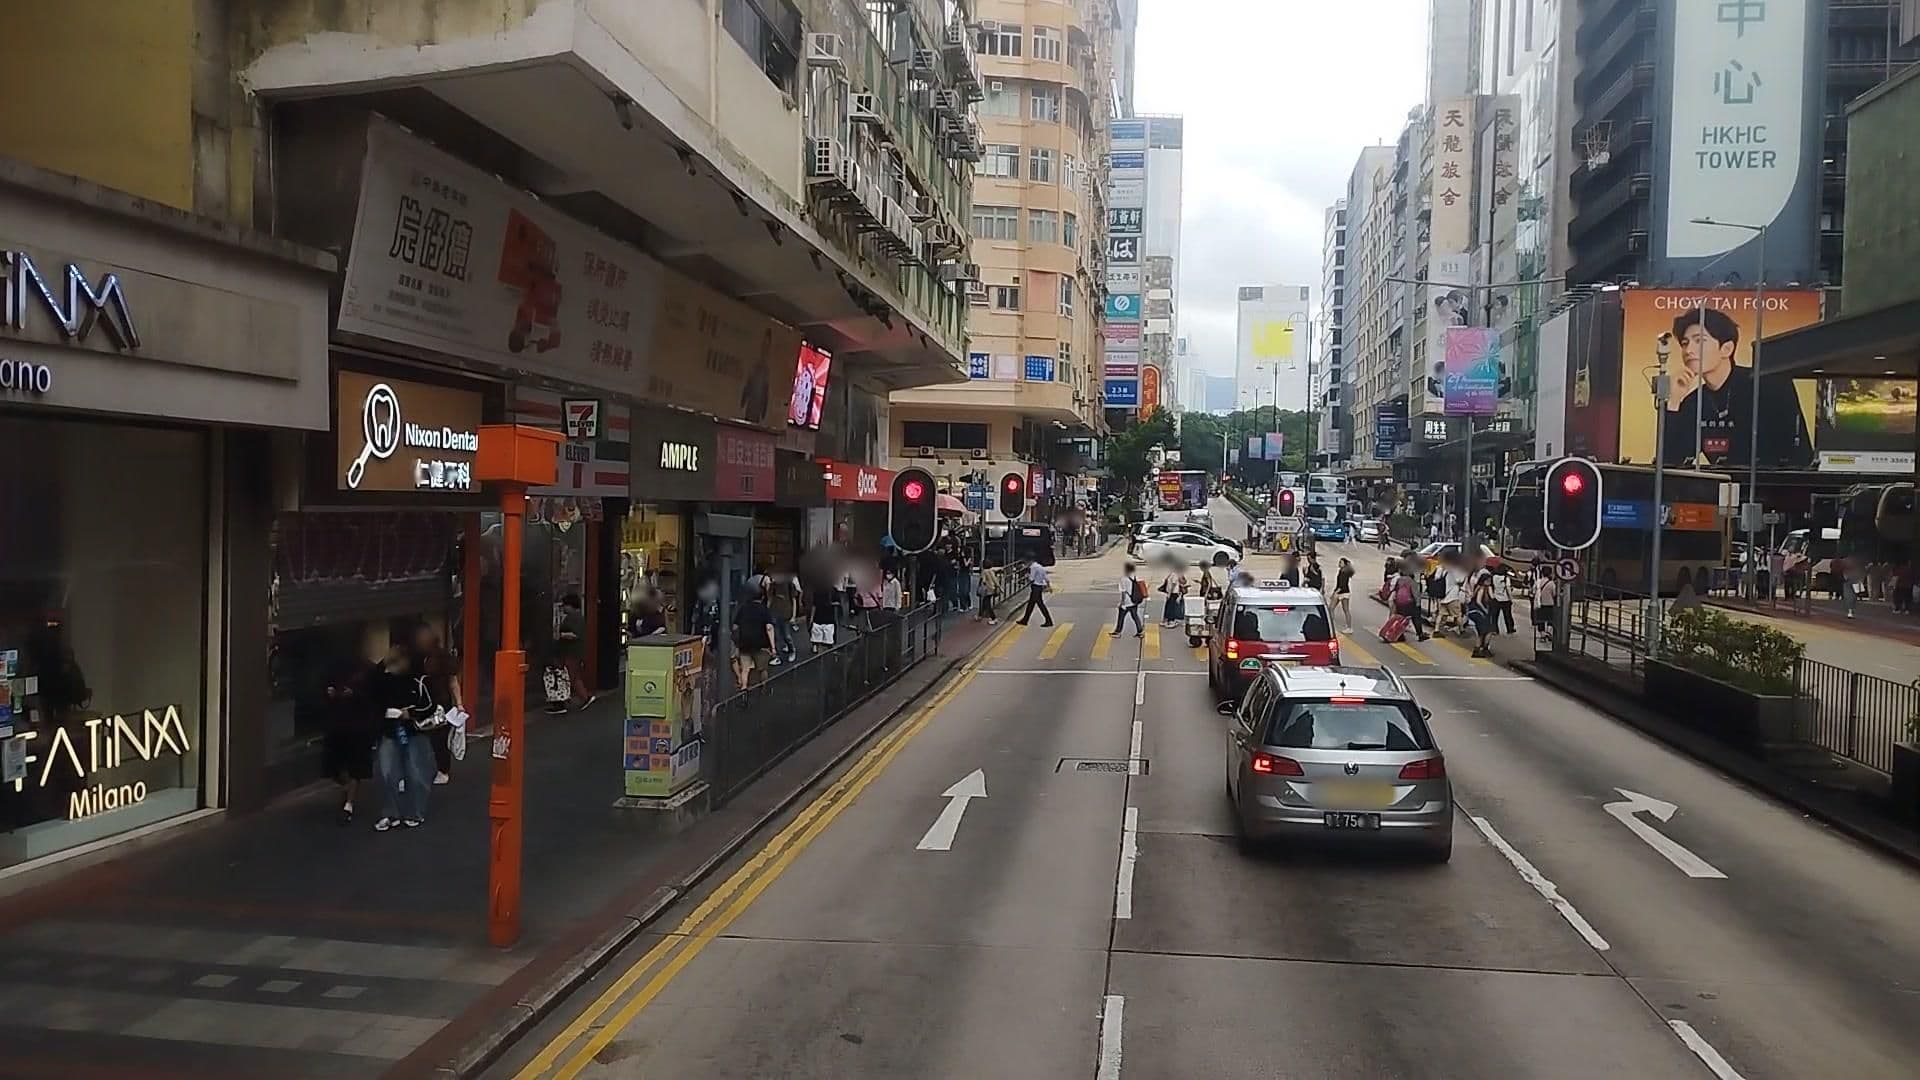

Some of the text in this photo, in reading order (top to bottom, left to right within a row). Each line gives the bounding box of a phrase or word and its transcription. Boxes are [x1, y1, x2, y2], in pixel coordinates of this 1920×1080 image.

[1702, 125, 1767, 144] HKHC
[1440, 110, 1464, 206] 天龍旅舍
[1695, 150, 1777, 169] TOWER
[1655, 296, 1706, 310] CHOW
[1712, 297, 1737, 310] TAI
[405, 422, 441, 449] Nixon
[660, 442, 698, 471] AMPLE
[69, 780, 147, 820] Milano
